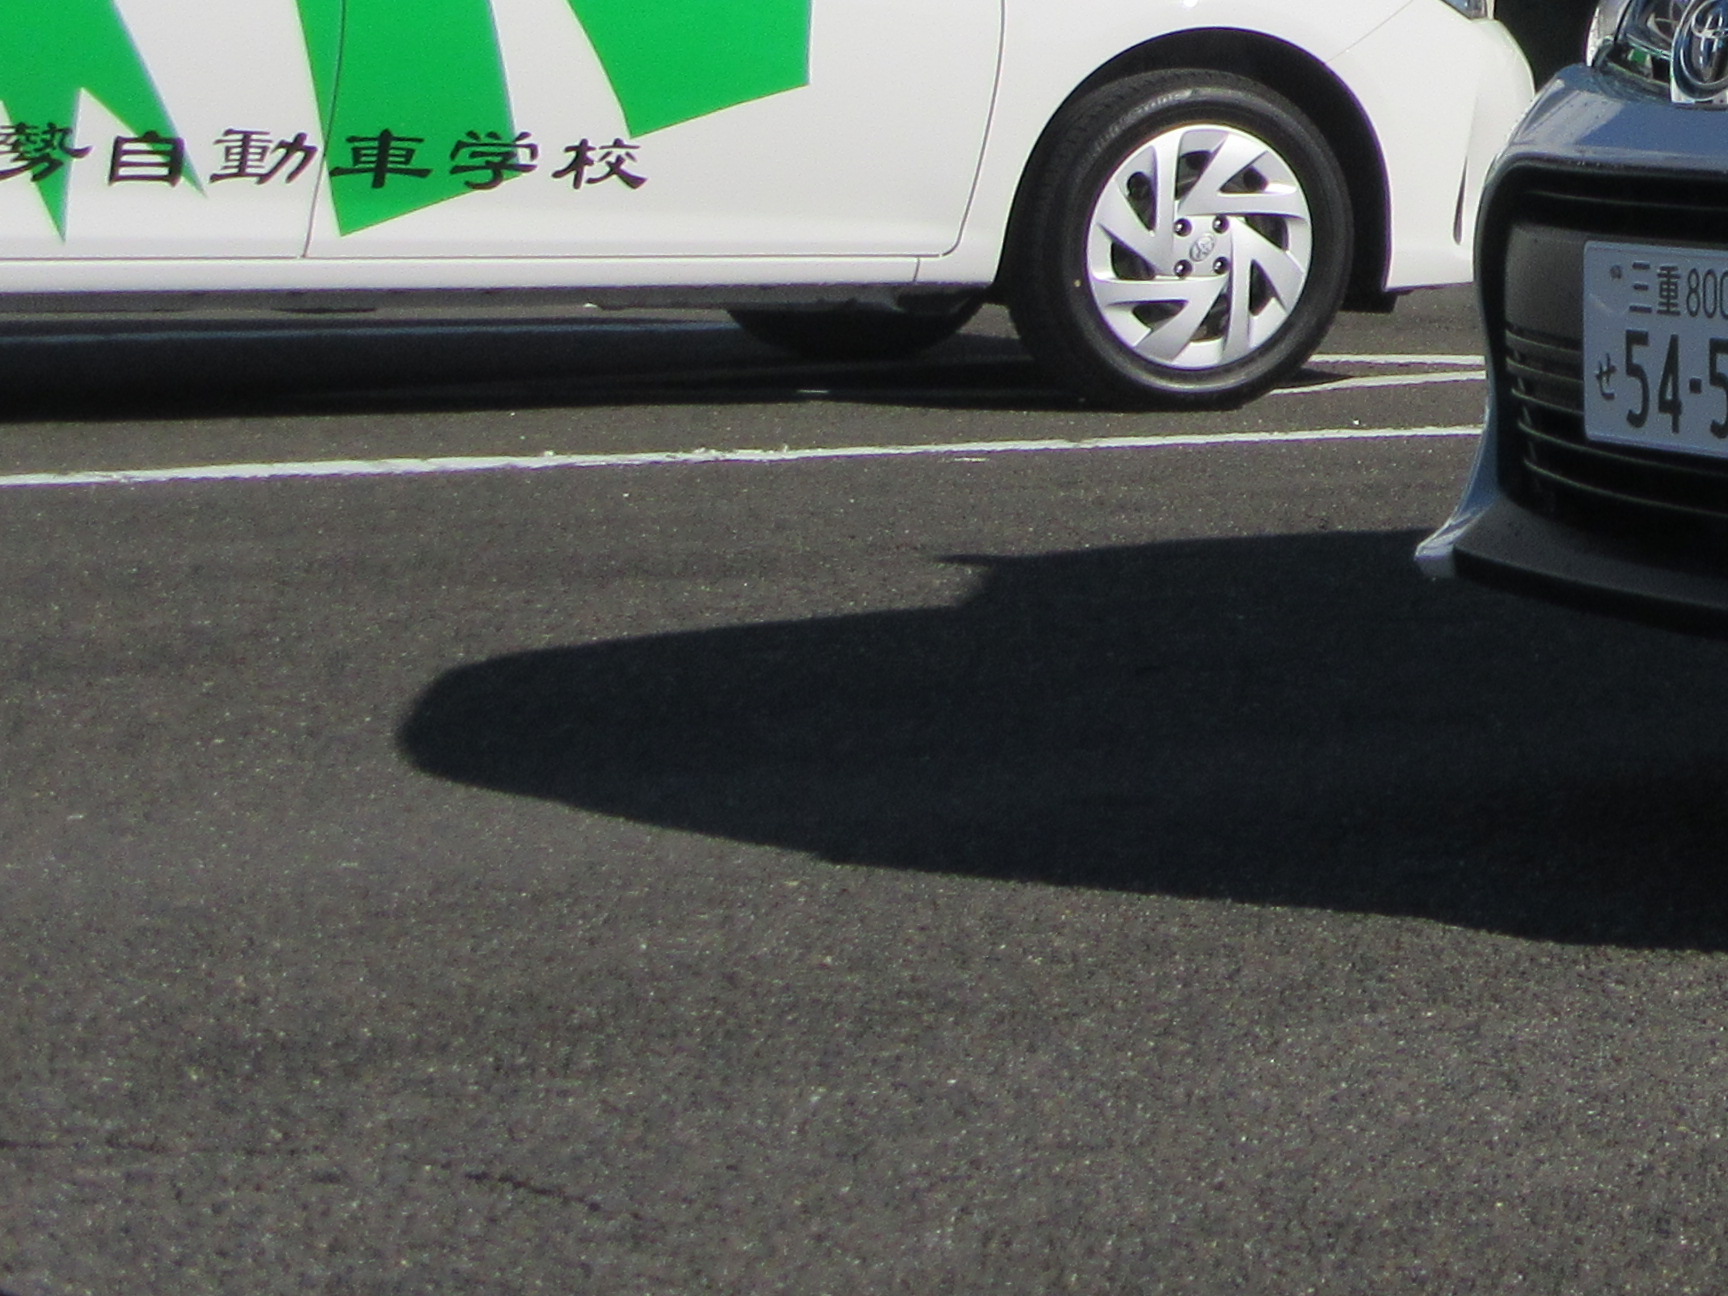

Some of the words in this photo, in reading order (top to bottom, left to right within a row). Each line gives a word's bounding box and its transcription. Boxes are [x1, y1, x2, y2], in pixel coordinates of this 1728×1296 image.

[0, 121, 649, 191] 勢自動車学校
[1594, 352, 1617, 401] せ
